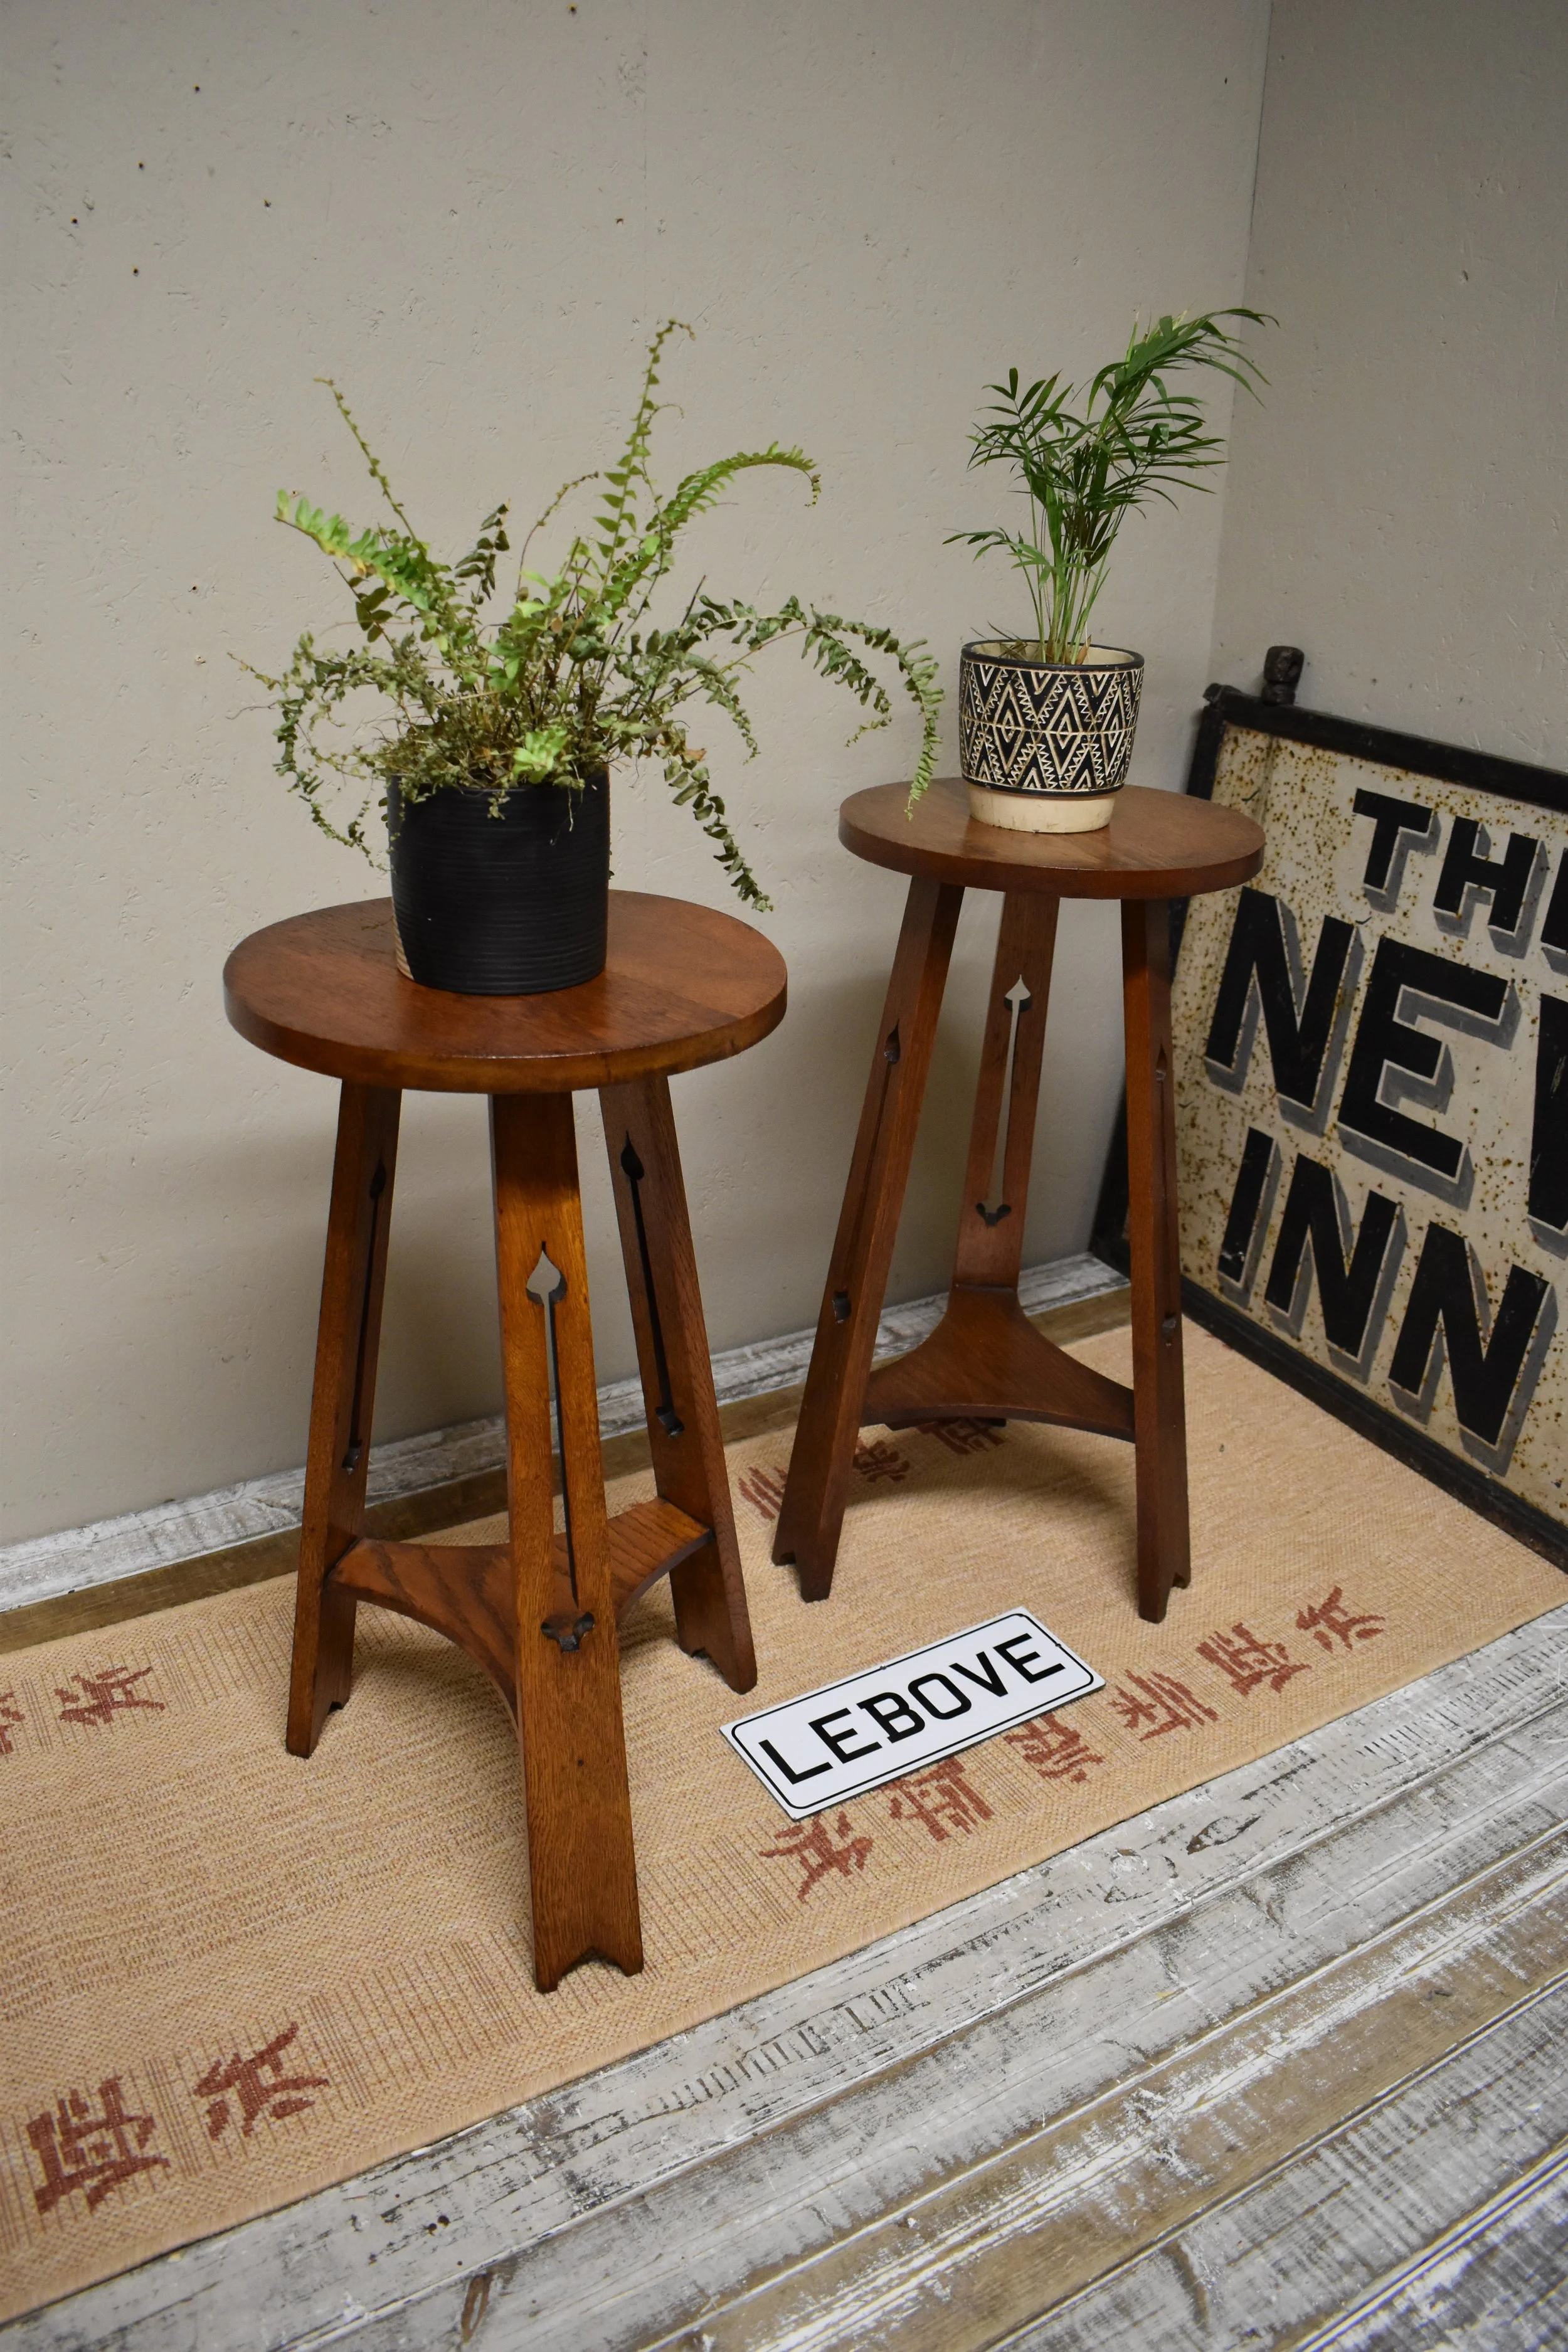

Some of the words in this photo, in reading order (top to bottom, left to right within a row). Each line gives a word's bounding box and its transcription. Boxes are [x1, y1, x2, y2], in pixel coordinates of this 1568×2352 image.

[1204, 886, 1568, 1245] NE
[1217, 1127, 1554, 1465] INN
[758, 1633, 1066, 1784] LEBOVE
